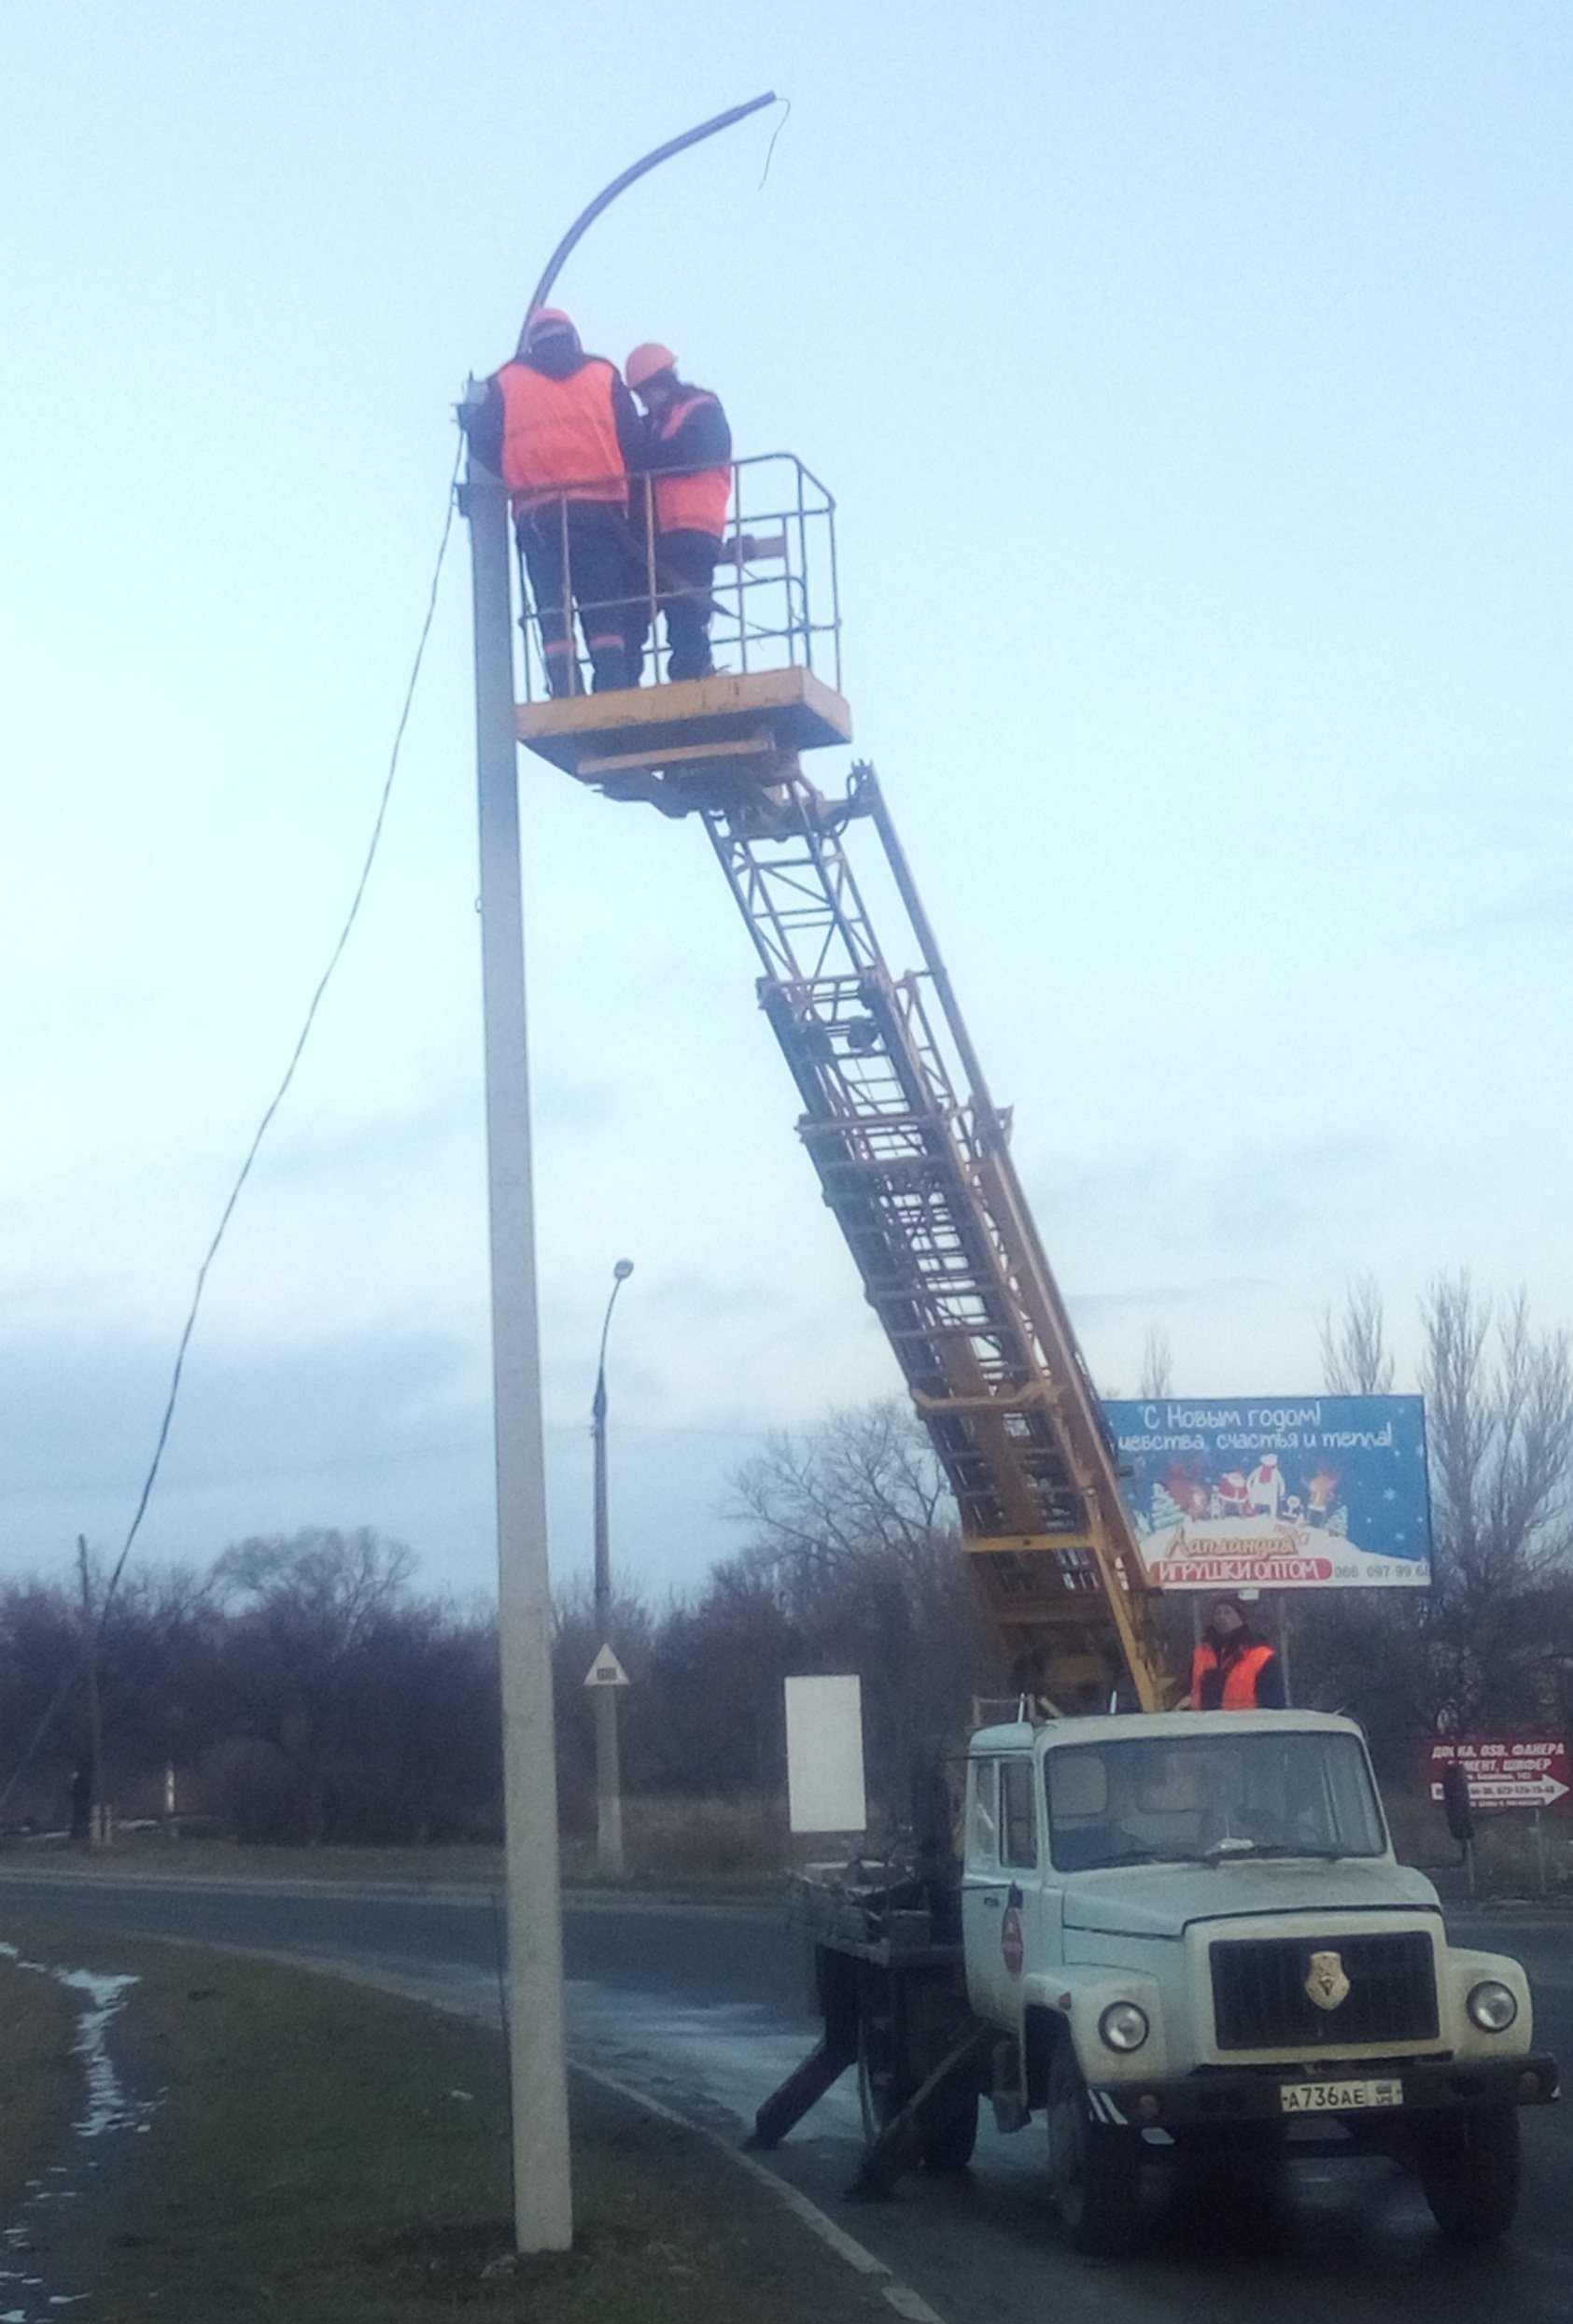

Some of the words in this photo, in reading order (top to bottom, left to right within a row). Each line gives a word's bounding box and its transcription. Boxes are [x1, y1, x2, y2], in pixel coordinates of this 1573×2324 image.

[1144, 1404, 1160, 1430] С
[1167, 1404, 1242, 1430] Новым
[1247, 1401, 1322, 1432] годом!
[1215, 1431, 1299, 1450] счастья
[1302, 1432, 1317, 1449] и
[1321, 1421, 1392, 1451] тепла!
[1159, 1560, 1252, 1582] ИГРУШКИ
[1255, 1559, 1319, 1581] ОПТОМ
[1511, 1742, 1565, 1756] ФАНЕРА
